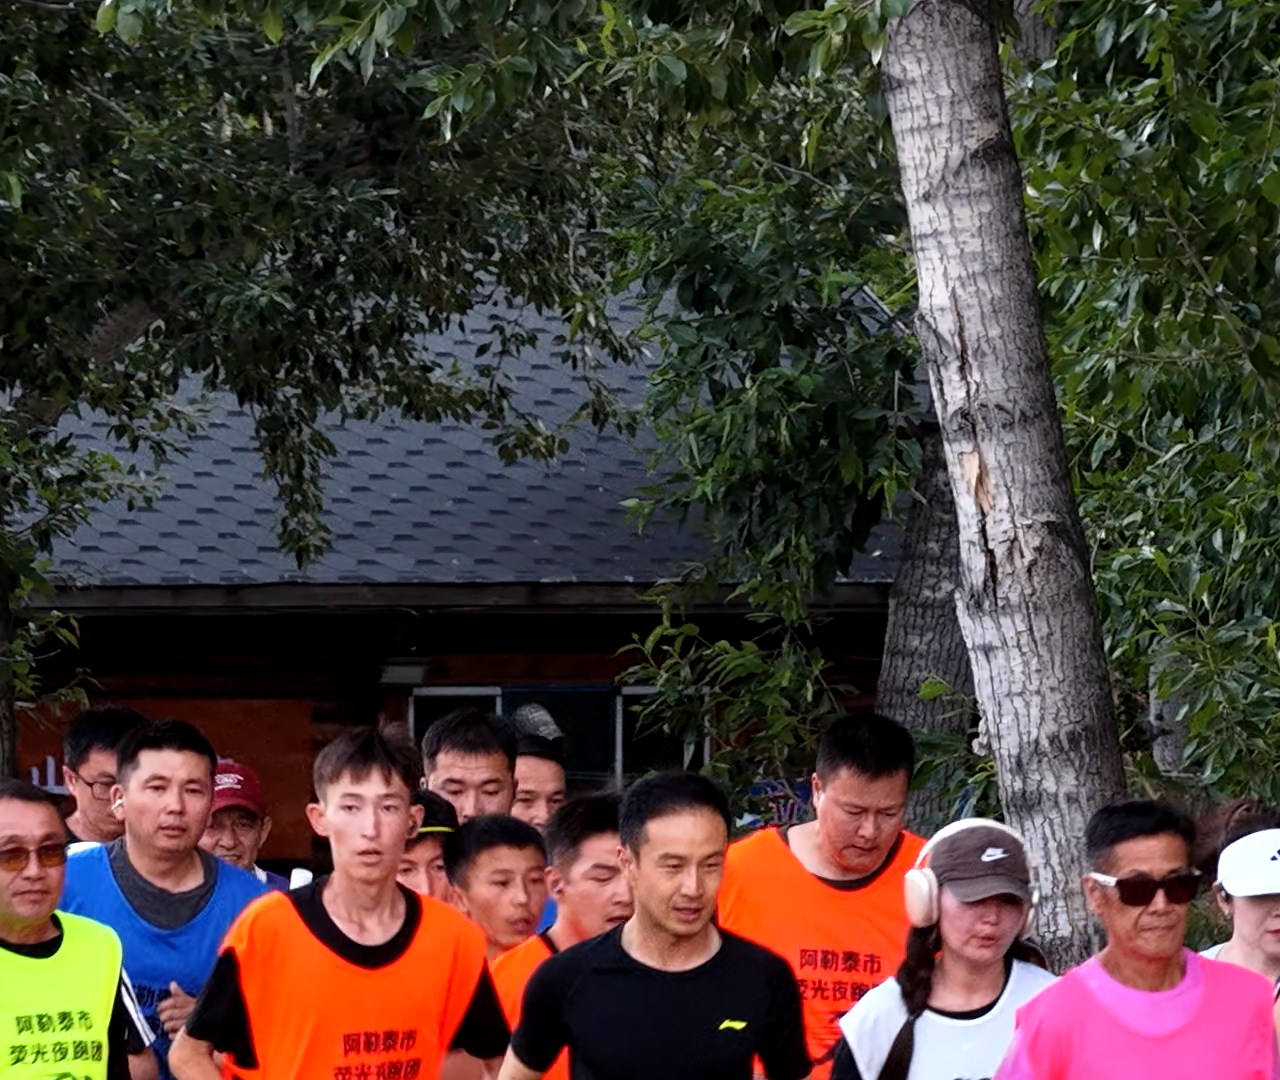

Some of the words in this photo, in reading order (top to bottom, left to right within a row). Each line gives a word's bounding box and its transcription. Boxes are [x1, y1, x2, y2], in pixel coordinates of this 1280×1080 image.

[800, 949, 882, 976] 阿勒泰市
[343, 1028, 417, 1057] 阿勒泰市
